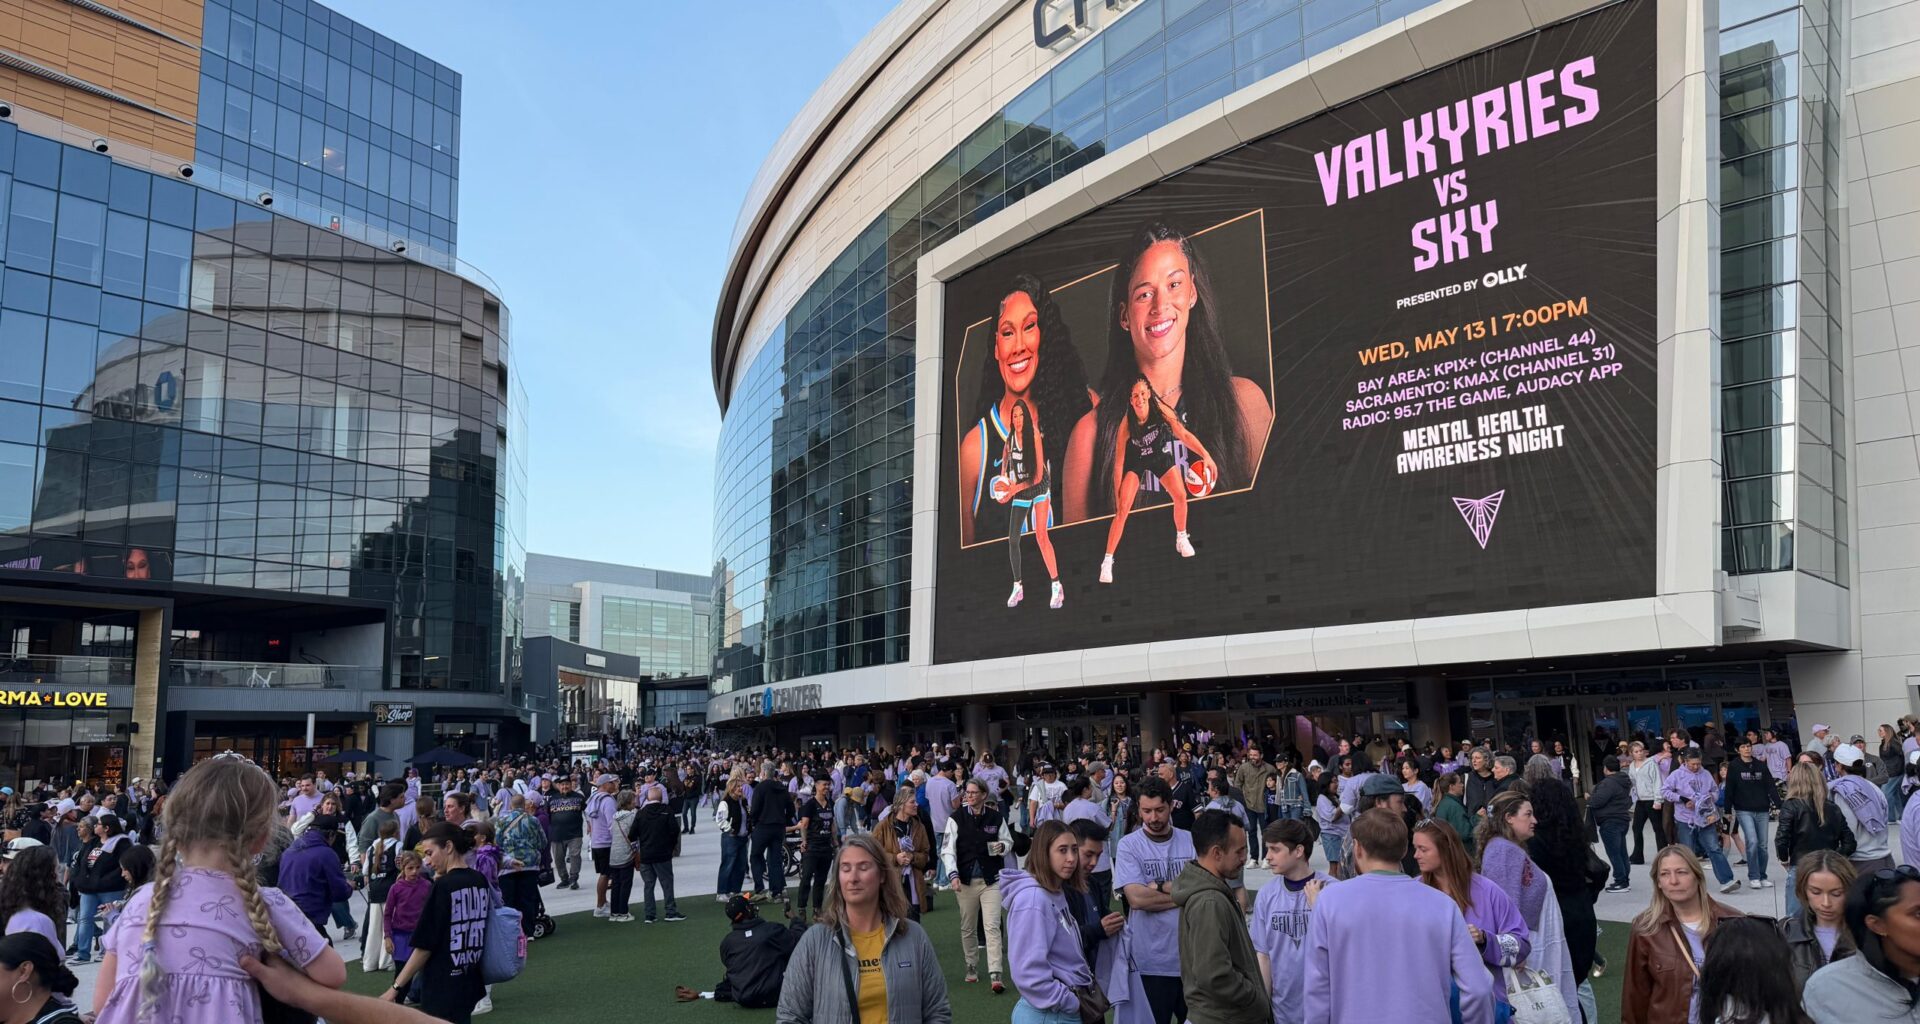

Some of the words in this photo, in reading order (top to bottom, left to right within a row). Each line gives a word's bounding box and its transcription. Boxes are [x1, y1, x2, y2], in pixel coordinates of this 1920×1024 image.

[1314, 56, 1600, 207] VALKYRIES
[1433, 169, 1468, 208] VS
[1411, 199, 1499, 272] SKY
[1396, 284, 1462, 309] PRESENTED
[1463, 279, 1478, 291] BY
[1358, 341, 1409, 366] WED,
[1414, 327, 1459, 354] MAY
[1463, 320, 1486, 341] 13
[1502, 296, 1589, 332] 7:00PM
[1345, 380, 1450, 413] SACRAMENTO:
[1453, 369, 1500, 390] KMAX
[1502, 351, 1589, 382] (CHANNEL
[1591, 343, 1617, 361] 31)
[1357, 377, 1385, 394] BAY
[1387, 367, 1431, 388] AREA:
[1434, 357, 1477, 377] KPIX+
[1480, 338, 1564, 368] (CHANNEL
[1567, 328, 1597, 347] 44)
[1342, 408, 1391, 430] RADIO:
[1394, 402, 1423, 420] 95.7
[1425, 393, 1457, 414] THE
[1459, 385, 1511, 406] GAME,
[1515, 369, 1584, 396] AUDACY
[1588, 362, 1624, 382] APP
[1396, 436, 1502, 474] AWARENESS
[1508, 425, 1565, 455] NIGHT
[1402, 419, 1473, 450] MENTAL
[1478, 404, 1548, 438] HEALTH
[1141, 446, 1154, 456] 22
[54, 691, 108, 707] LOVE
[387, 709, 413, 723] Shop
[733, 692, 764, 718] CHASE
[772, 683, 822, 713] CENTER
